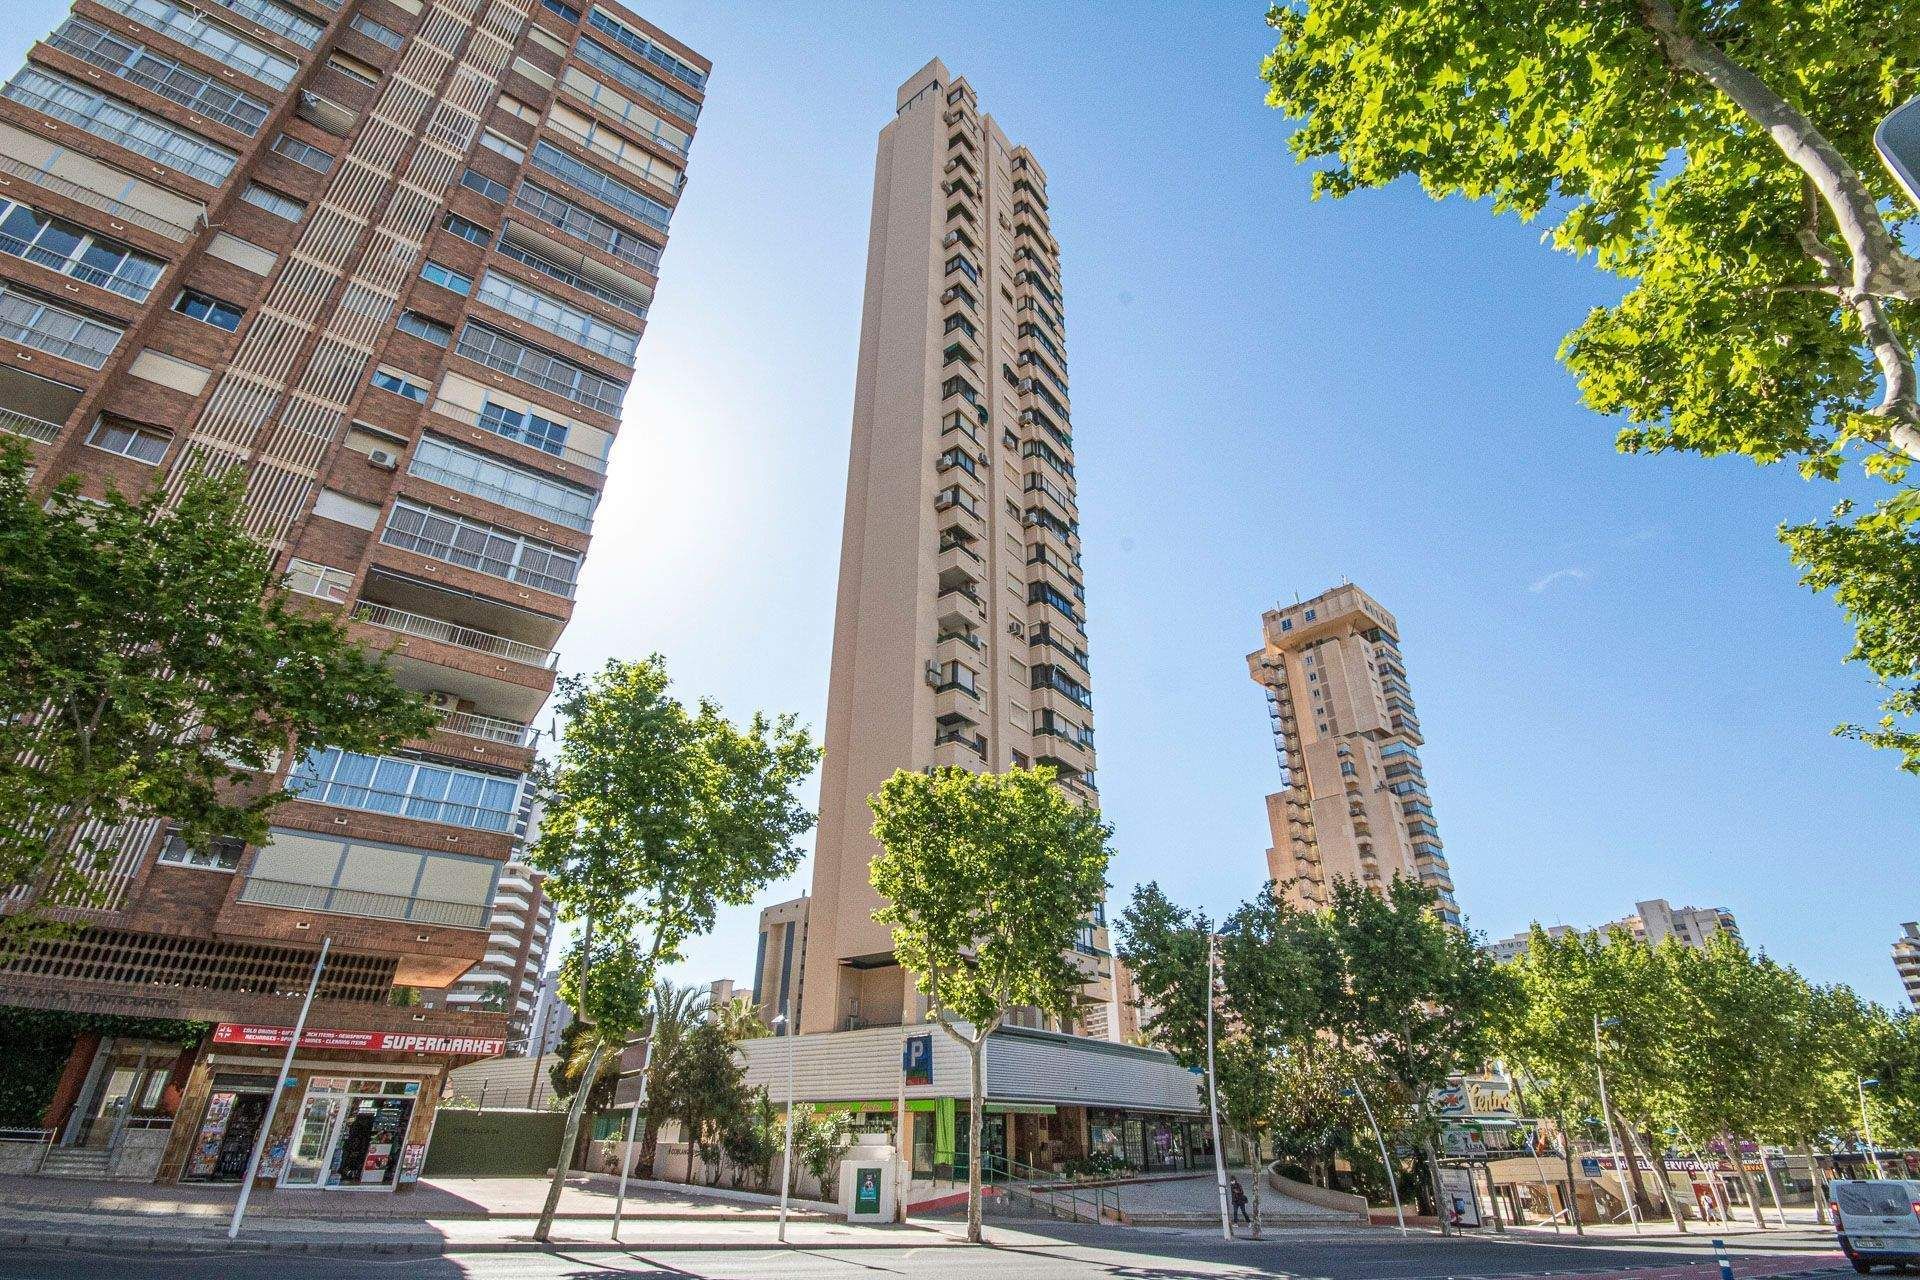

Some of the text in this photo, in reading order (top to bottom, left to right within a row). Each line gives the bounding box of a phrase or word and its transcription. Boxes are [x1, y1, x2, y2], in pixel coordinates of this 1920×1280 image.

[381, 1035, 504, 1053] SUPERMARKET
[911, 1040, 924, 1067] P
[1664, 1160, 1719, 1170] ERVIGROUP
